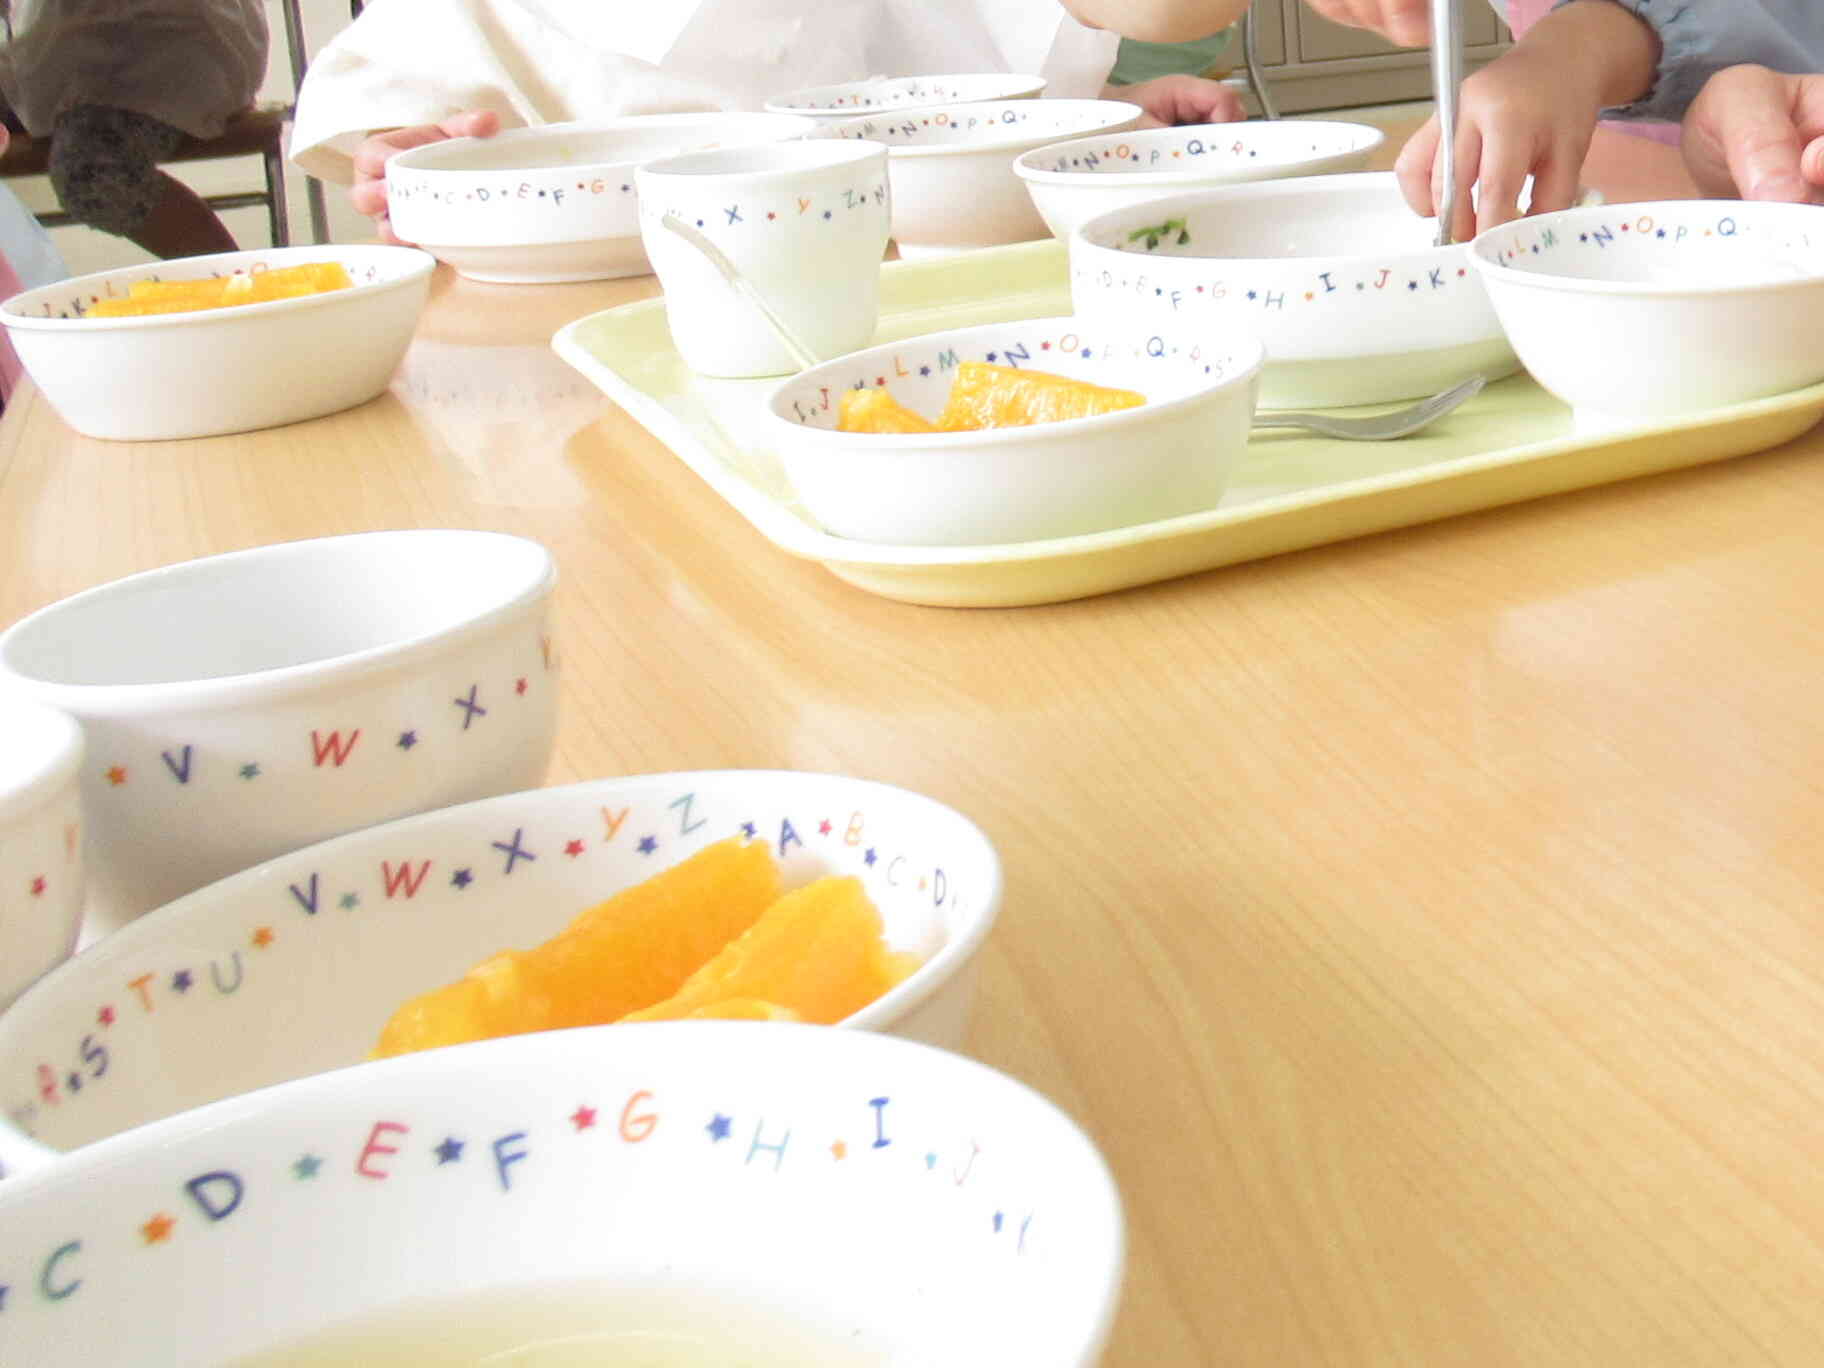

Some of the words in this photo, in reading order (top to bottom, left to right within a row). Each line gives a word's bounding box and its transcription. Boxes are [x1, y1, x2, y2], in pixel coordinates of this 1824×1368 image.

[1002, 110, 1016, 124] Q
[1085, 152, 1099, 170] N
[1116, 144, 1129, 159] O
[1151, 151, 1159, 165] P
[1187, 140, 1204, 154] Q
[476, 188, 489, 201] D
[517, 183, 530, 198] E
[554, 188, 566, 206] F
[592, 179, 605, 193] G
[724, 205, 744, 226] X
[799, 199, 810, 215] Y
[842, 190, 857, 208] Z
[1541, 229, 1558, 248] M
[1594, 225, 1614, 247] N
[1637, 216, 1654, 234] O
[1675, 226, 1687, 247] P
[1718, 218, 1737, 237] Q
[1171, 291, 1182, 310] F
[1212, 282, 1226, 298] G
[1265, 291, 1285, 310] H
[1320, 273, 1336, 292] I
[1374, 270, 1392, 289] J
[1428, 268, 1445, 288] K
[819, 388, 830, 410] J
[896, 356, 909, 376] L
[939, 349, 960, 370] M
[1004, 344, 1030, 369] N
[1060, 334, 1079, 353] O
[1147, 336, 1165, 358] Q
[162, 745, 193, 784] V
[312, 728, 360, 767] W
[454, 684, 487, 730] X
[36, 1063, 62, 1106] R
[78, 1035, 110, 1079] S
[128, 973, 155, 1015] T
[207, 951, 243, 995] U
[287, 871, 320, 917] V
[378, 859, 433, 901] W
[490, 828, 538, 875] X
[598, 805, 630, 842] Y
[668, 793, 708, 836] Z
[774, 817, 803, 856] A
[843, 812, 865, 848] B
[886, 855, 908, 887] C
[932, 867, 947, 907] D
[40, 1241, 85, 1300] C
[185, 1169, 243, 1220] D
[354, 1120, 408, 1180] E
[490, 1133, 530, 1191] F
[617, 1089, 659, 1143] G
[744, 1127, 791, 1171] H
[866, 1096, 890, 1149] I
